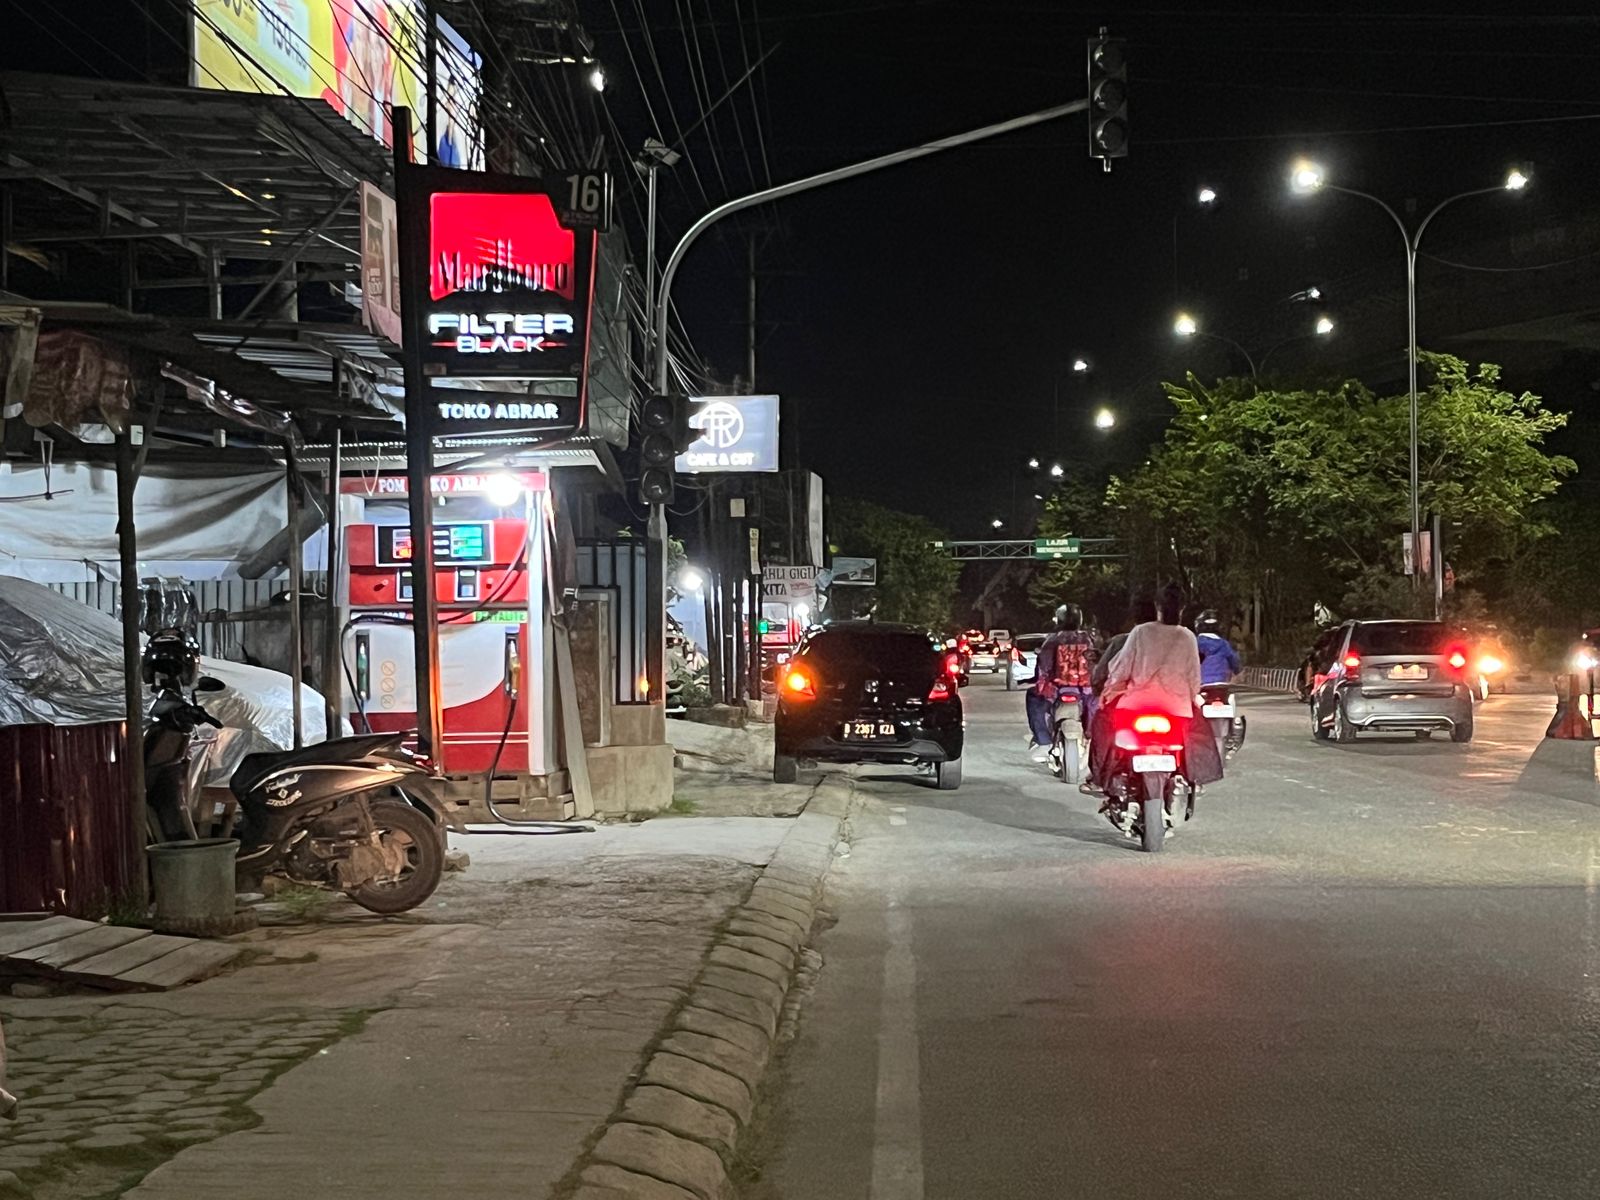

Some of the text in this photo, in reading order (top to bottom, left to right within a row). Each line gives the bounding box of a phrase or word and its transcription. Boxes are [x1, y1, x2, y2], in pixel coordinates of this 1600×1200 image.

[567, 174, 601, 213] 16
[429, 313, 574, 335] FILTER
[456, 335, 545, 353] BLACK
[438, 403, 559, 419] TOKO ABRAR
[378, 478, 406, 493] POM
[789, 566, 811, 580] GIGI
